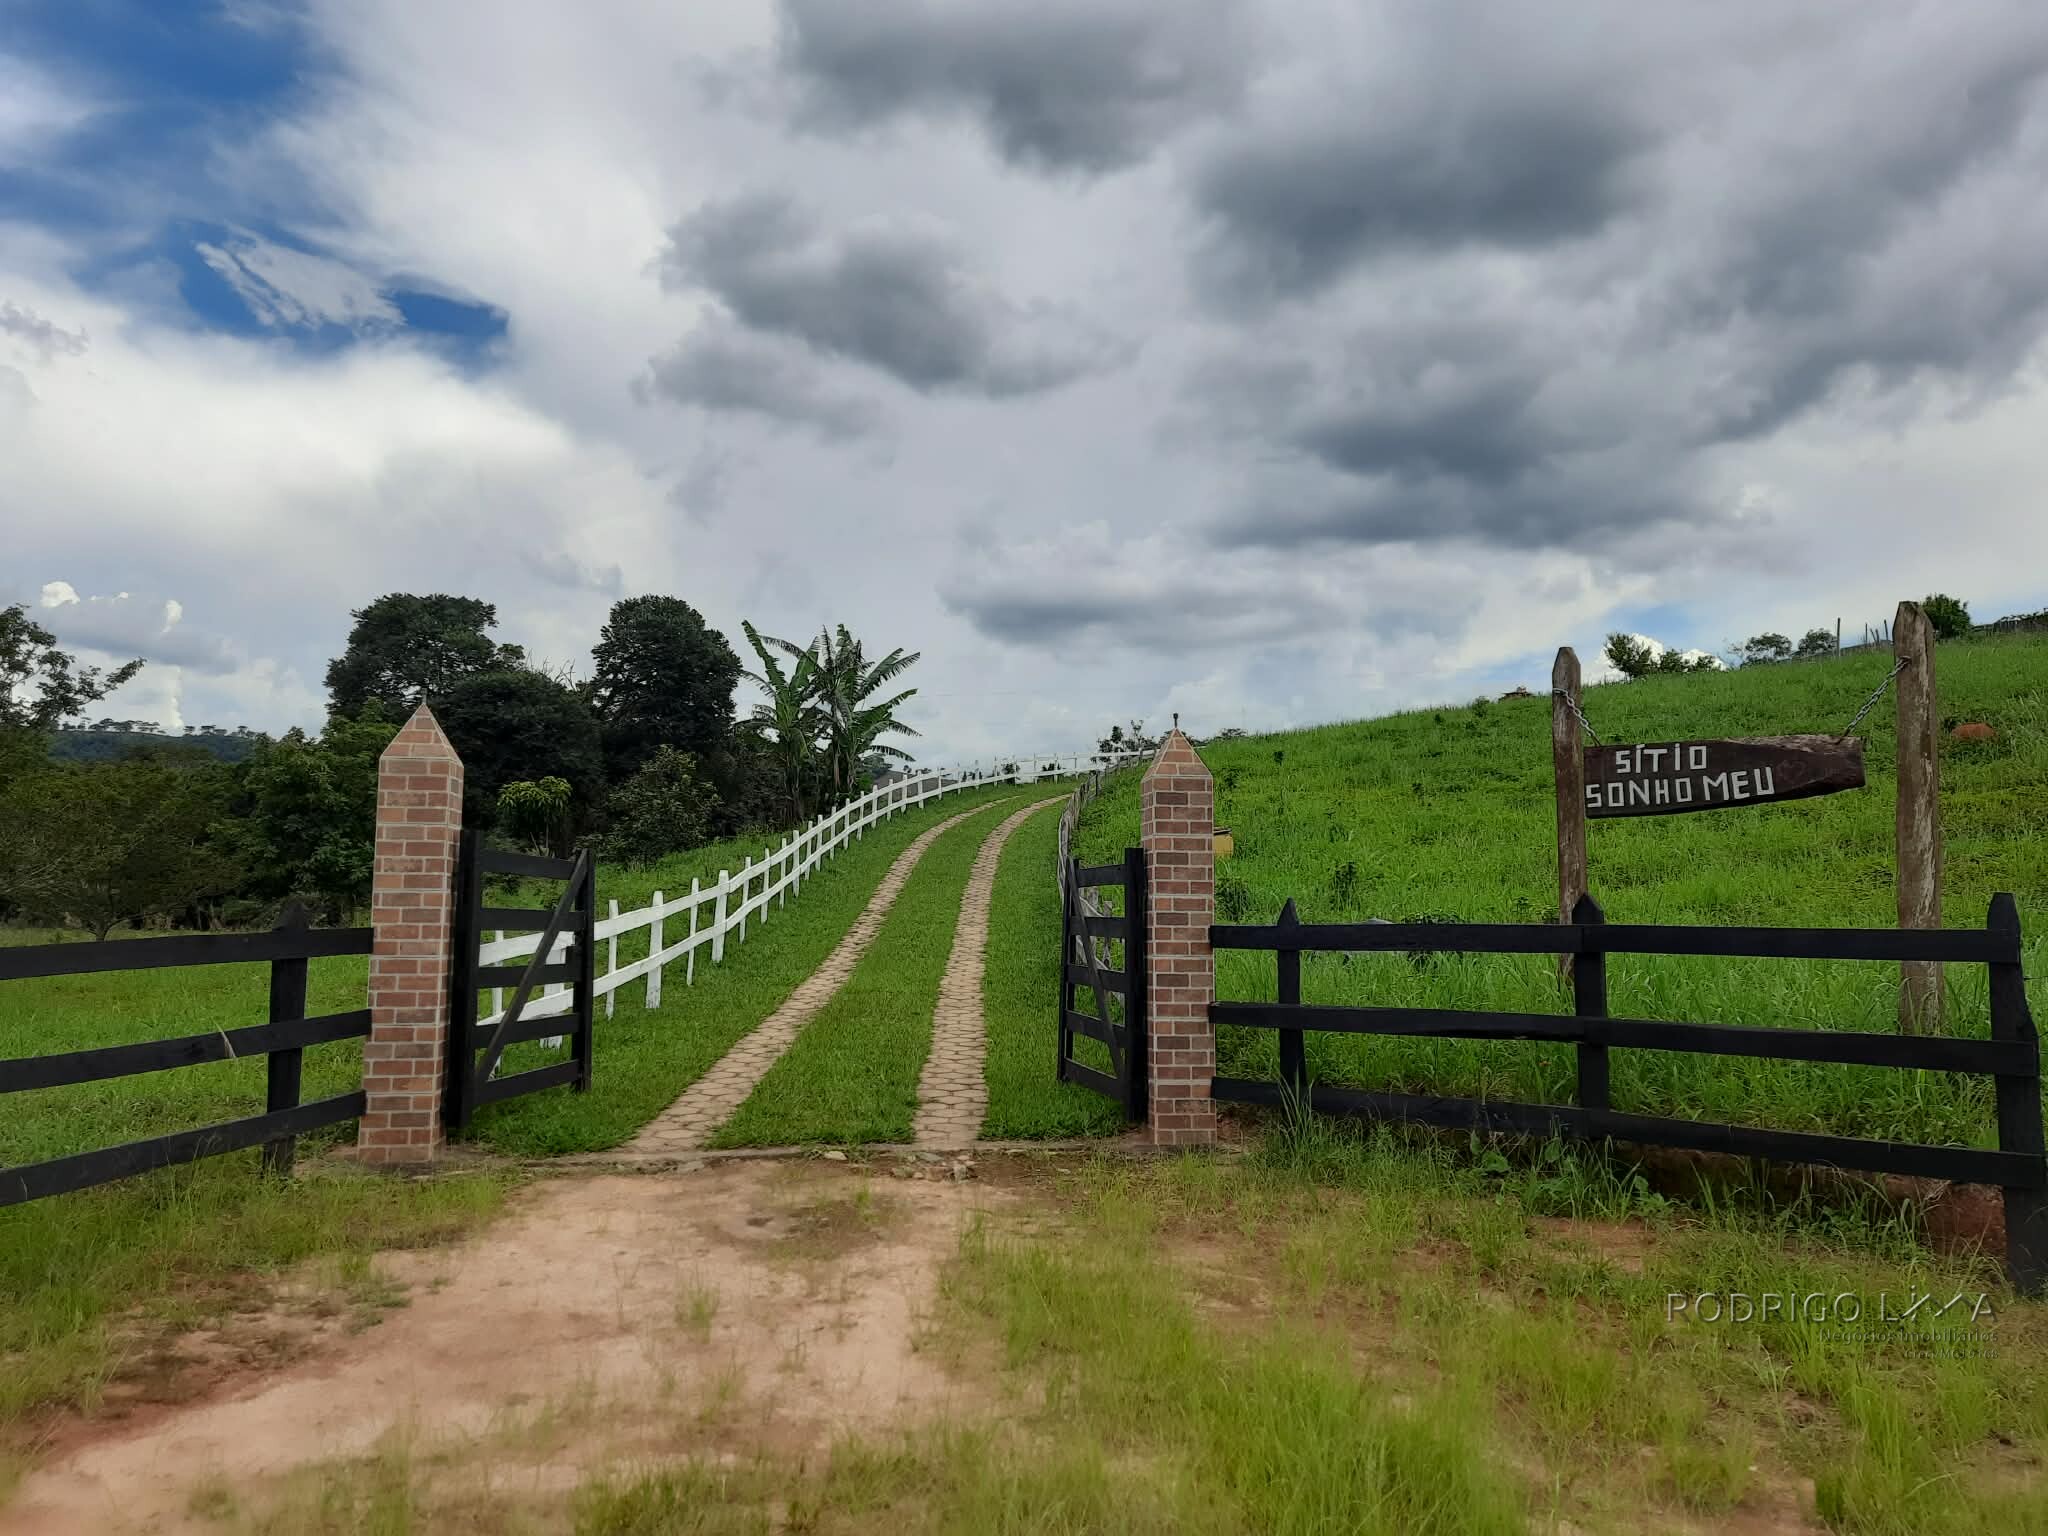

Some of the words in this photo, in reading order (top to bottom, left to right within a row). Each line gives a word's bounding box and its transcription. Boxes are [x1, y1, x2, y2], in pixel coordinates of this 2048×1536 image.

[1615, 743, 1707, 773] SÍTIO
[1586, 777, 1693, 807] SONHO
[1702, 766, 1775, 800] MEU
